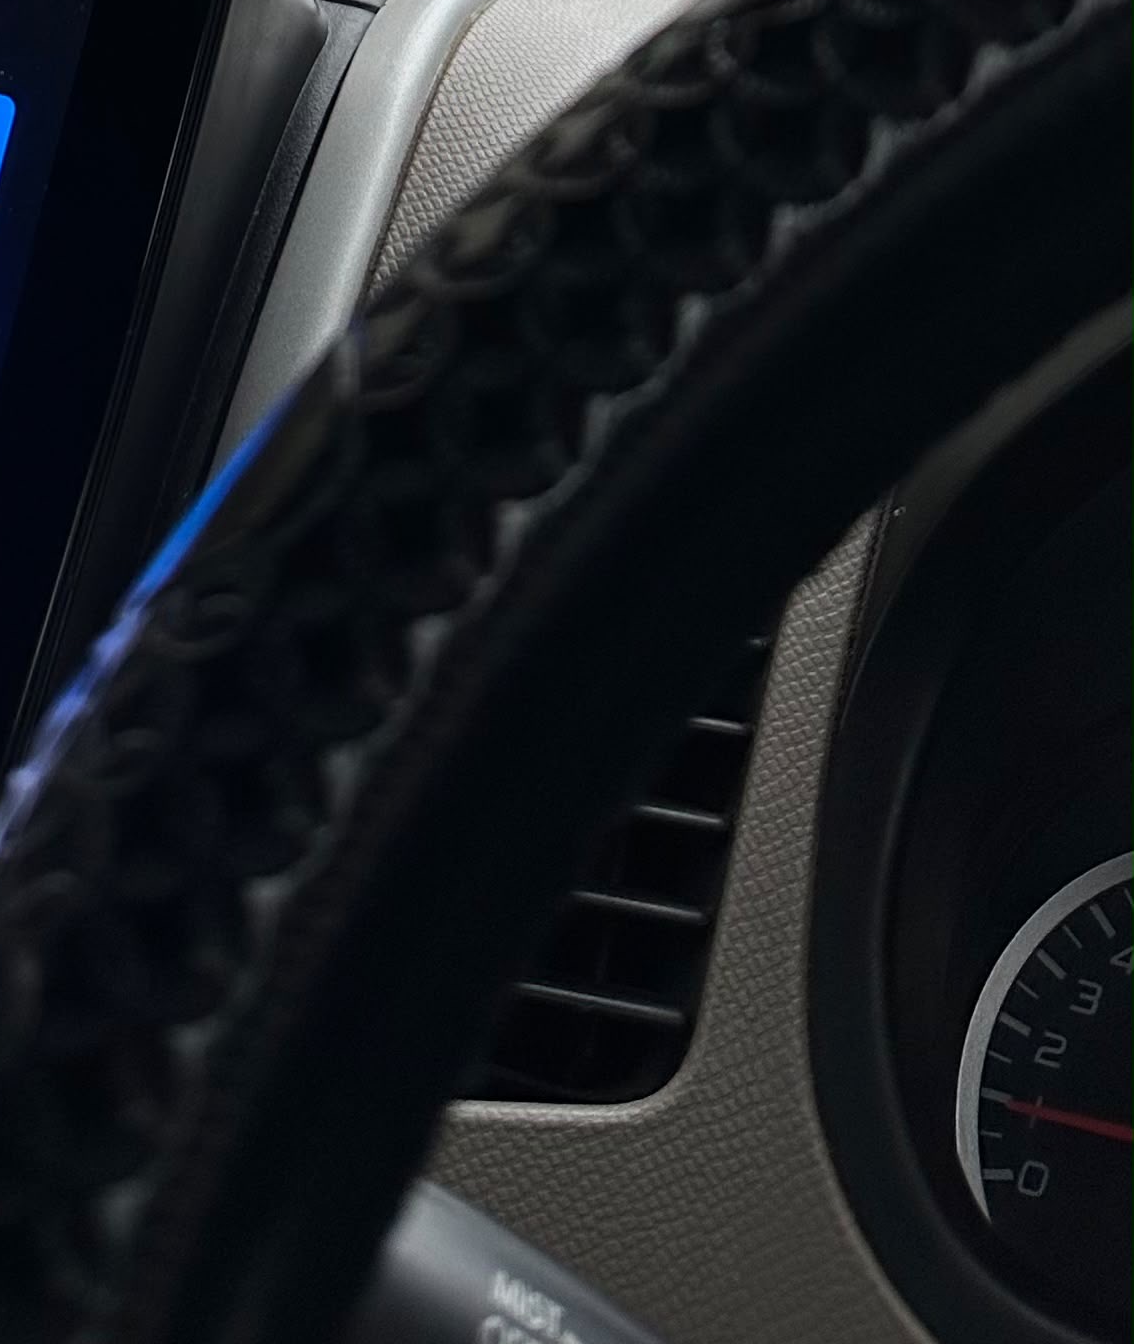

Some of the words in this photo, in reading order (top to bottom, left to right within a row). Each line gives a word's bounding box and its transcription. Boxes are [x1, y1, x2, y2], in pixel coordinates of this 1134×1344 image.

[1069, 979, 1103, 1015] 3
[1034, 1031, 1067, 1069] 2
[1018, 1161, 1049, 1197] 0
